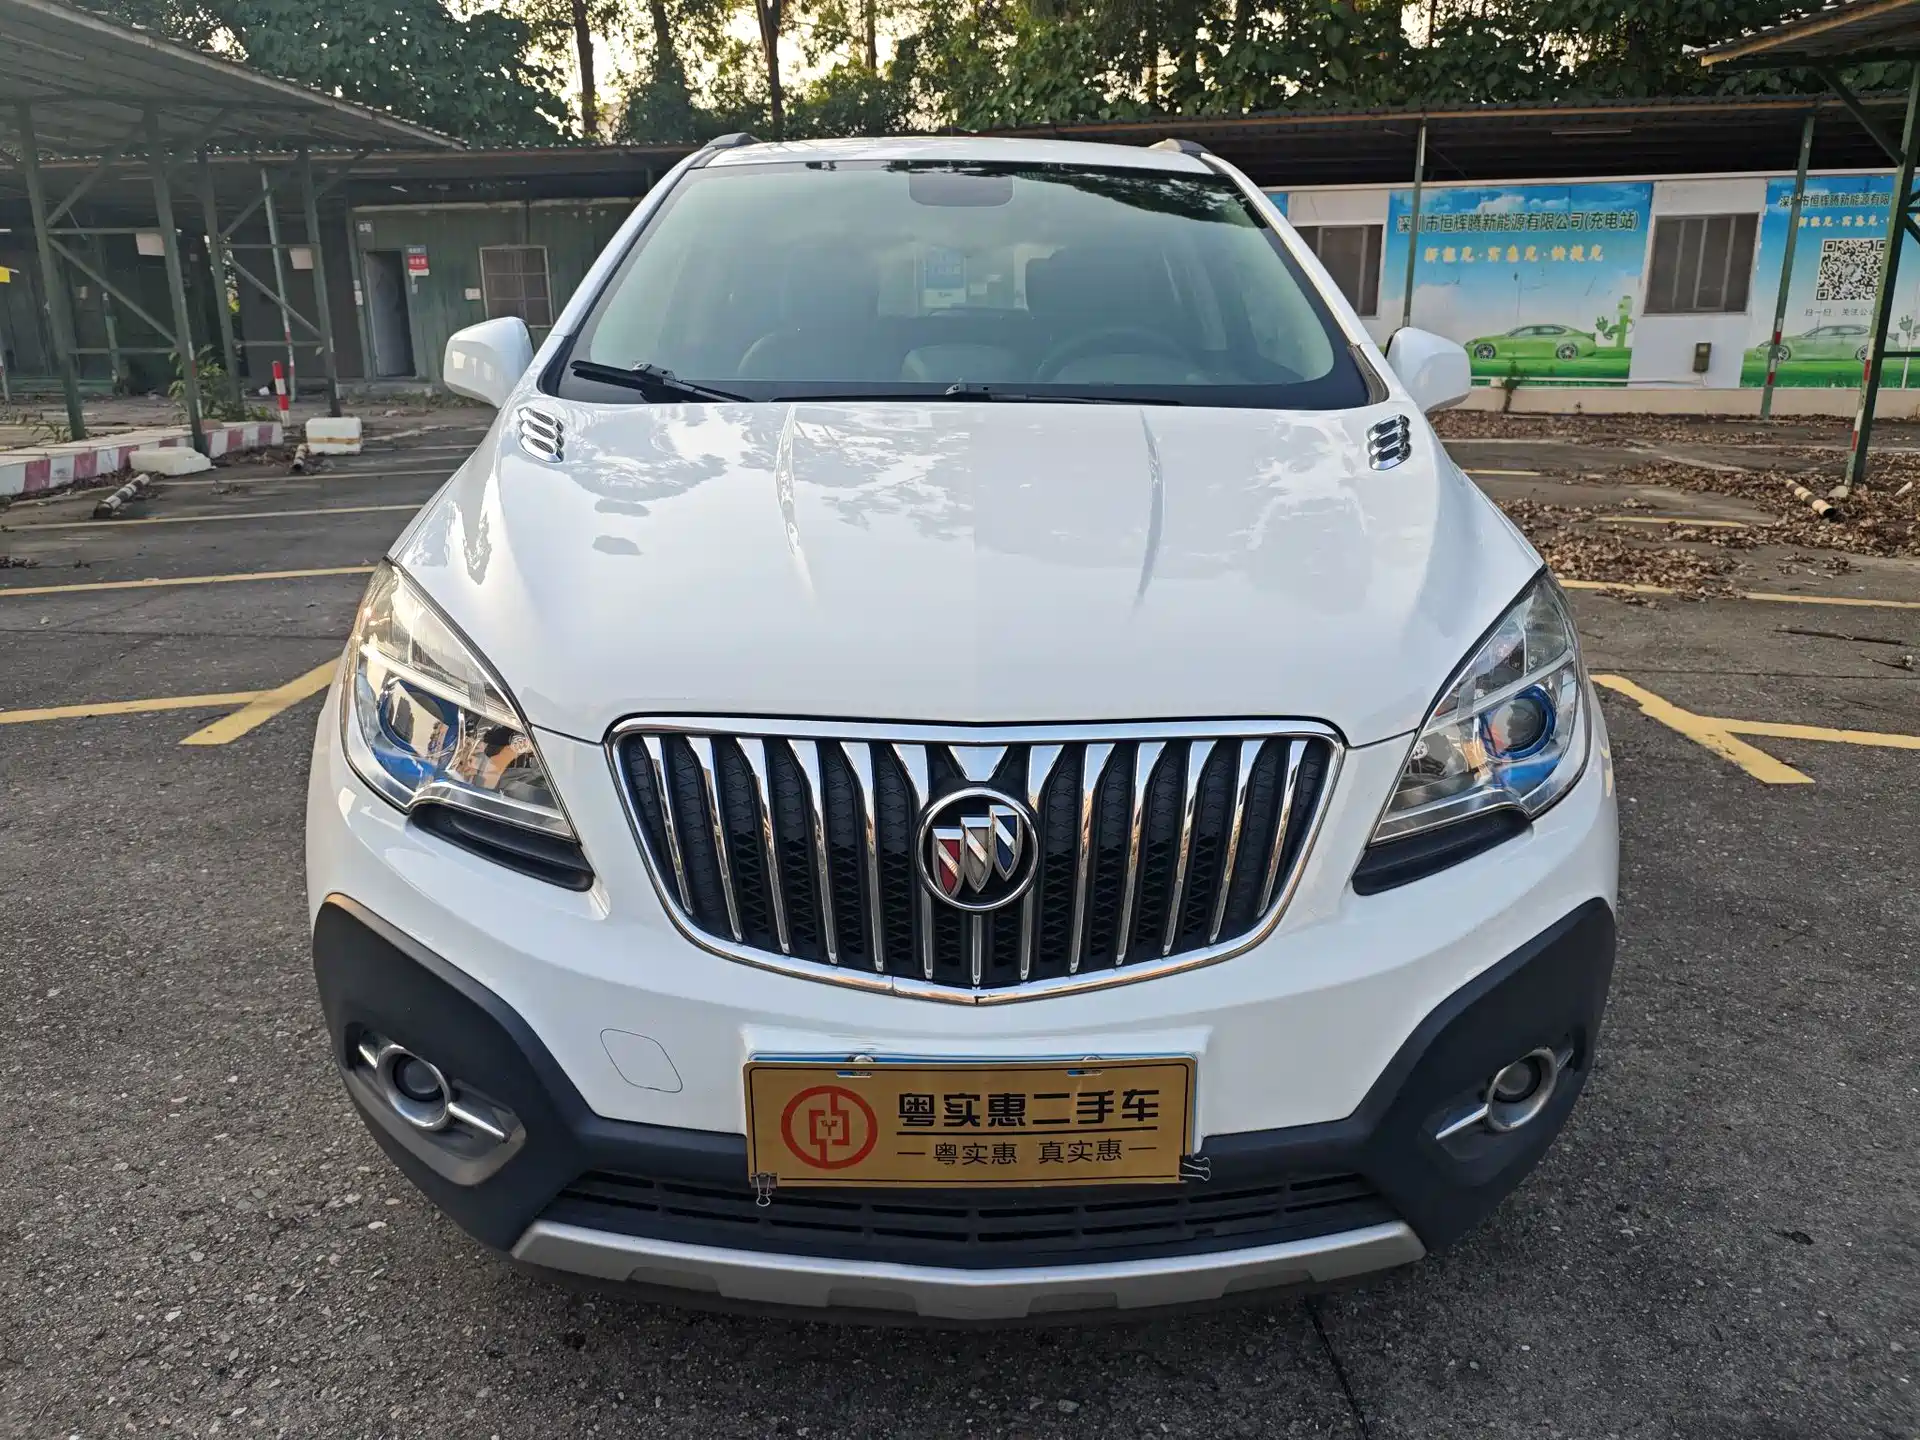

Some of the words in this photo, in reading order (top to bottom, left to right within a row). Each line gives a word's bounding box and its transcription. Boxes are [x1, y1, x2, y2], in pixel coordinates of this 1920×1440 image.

[897, 1089, 1160, 1128] 粤实惠二手车
[933, 1142, 1018, 1166] 粤实惠
[1038, 1138, 1123, 1164] 真实惠
